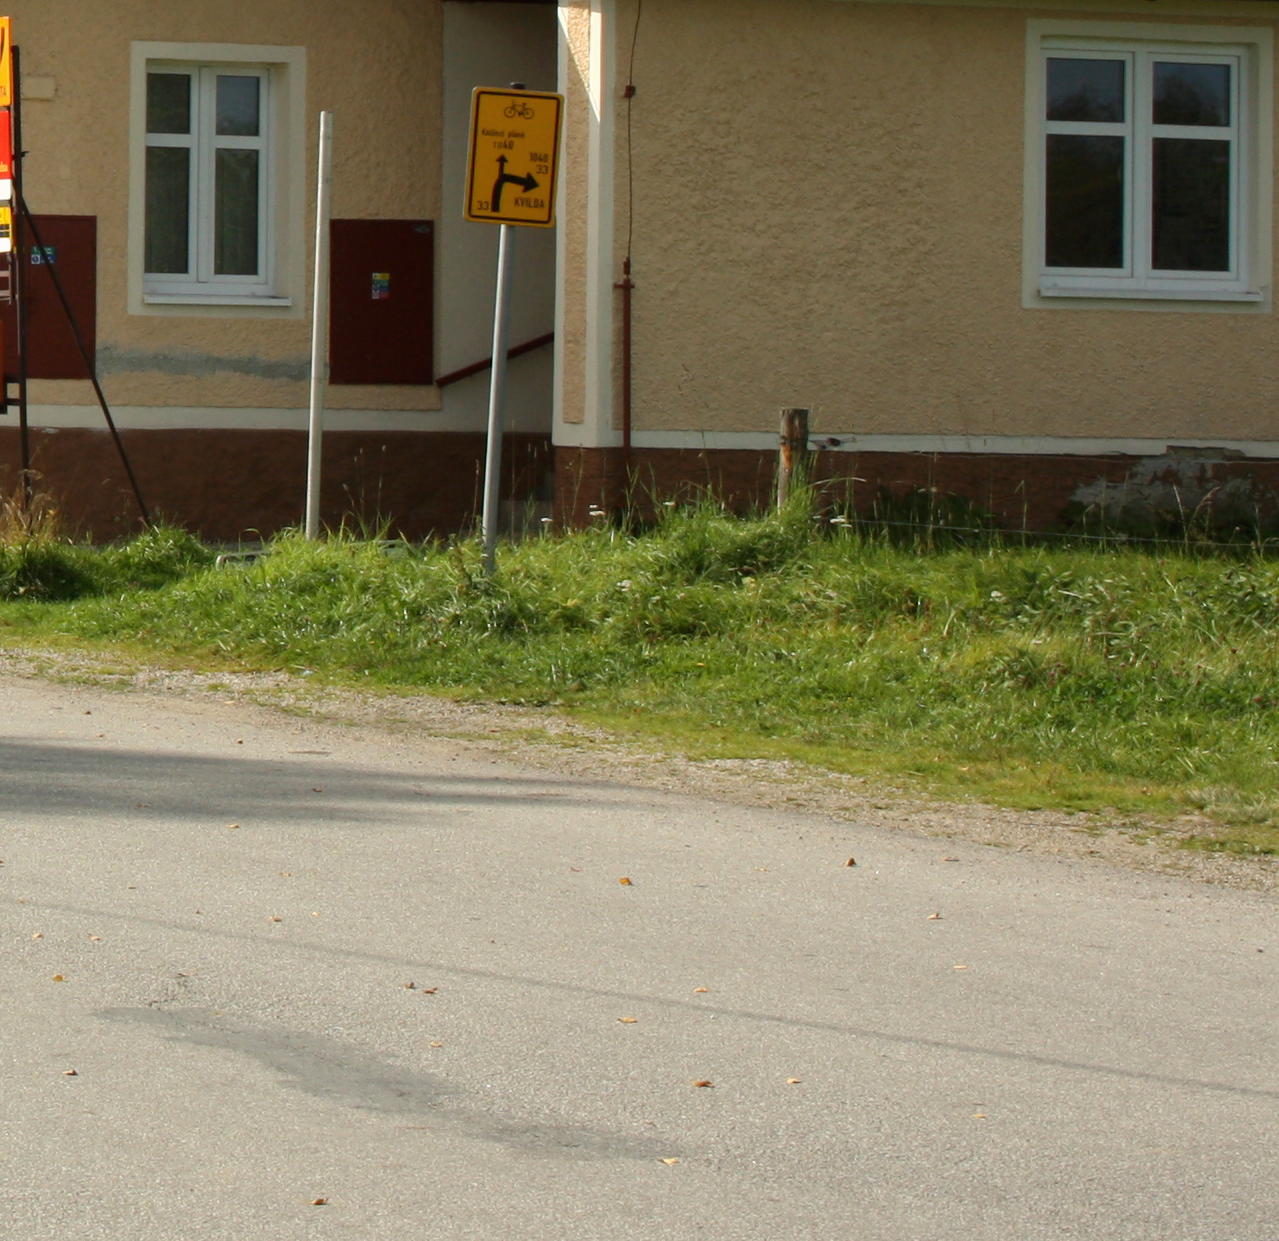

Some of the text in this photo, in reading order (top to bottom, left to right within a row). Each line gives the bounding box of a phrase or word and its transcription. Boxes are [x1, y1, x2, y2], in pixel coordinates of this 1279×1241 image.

[536, 164, 549, 175] 33
[477, 200, 490, 211] 33
[514, 196, 545, 209] KVILDA
